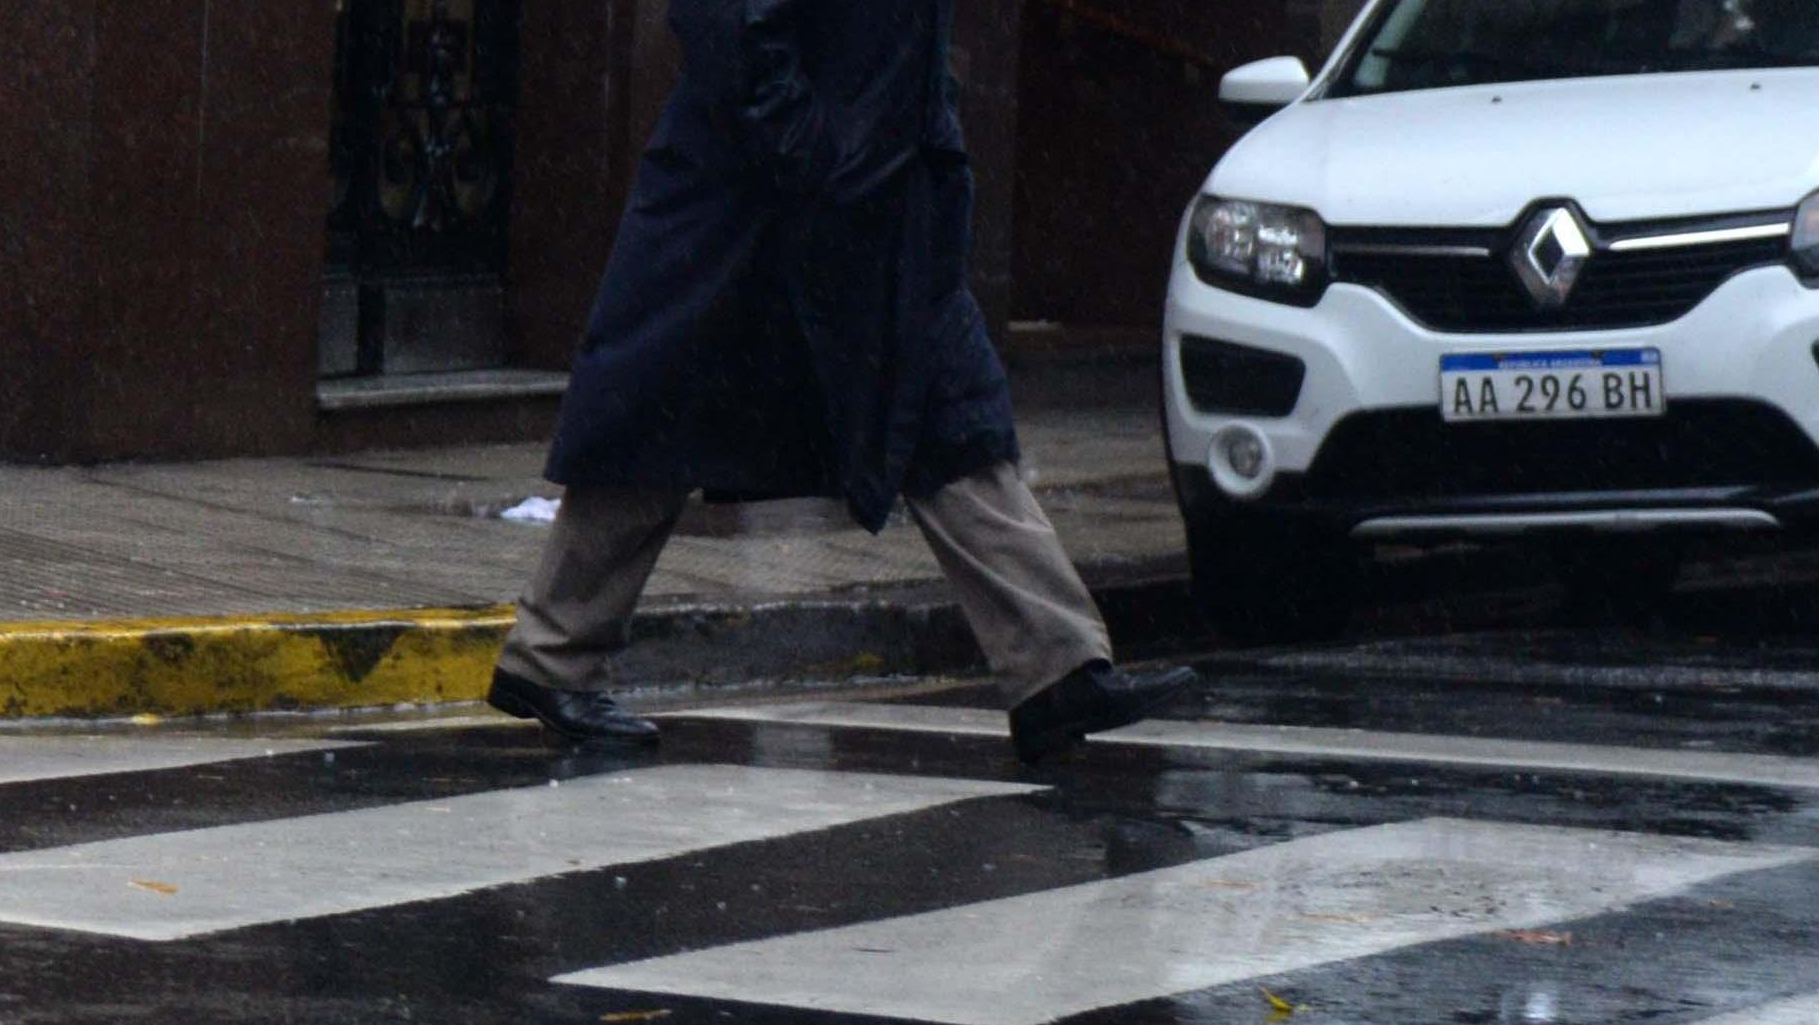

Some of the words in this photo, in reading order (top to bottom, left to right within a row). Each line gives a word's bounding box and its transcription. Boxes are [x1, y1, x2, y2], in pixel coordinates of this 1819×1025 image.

[1454, 376, 1499, 414] AA
[1514, 374, 1587, 412] 296
[1603, 372, 1652, 410] BH
